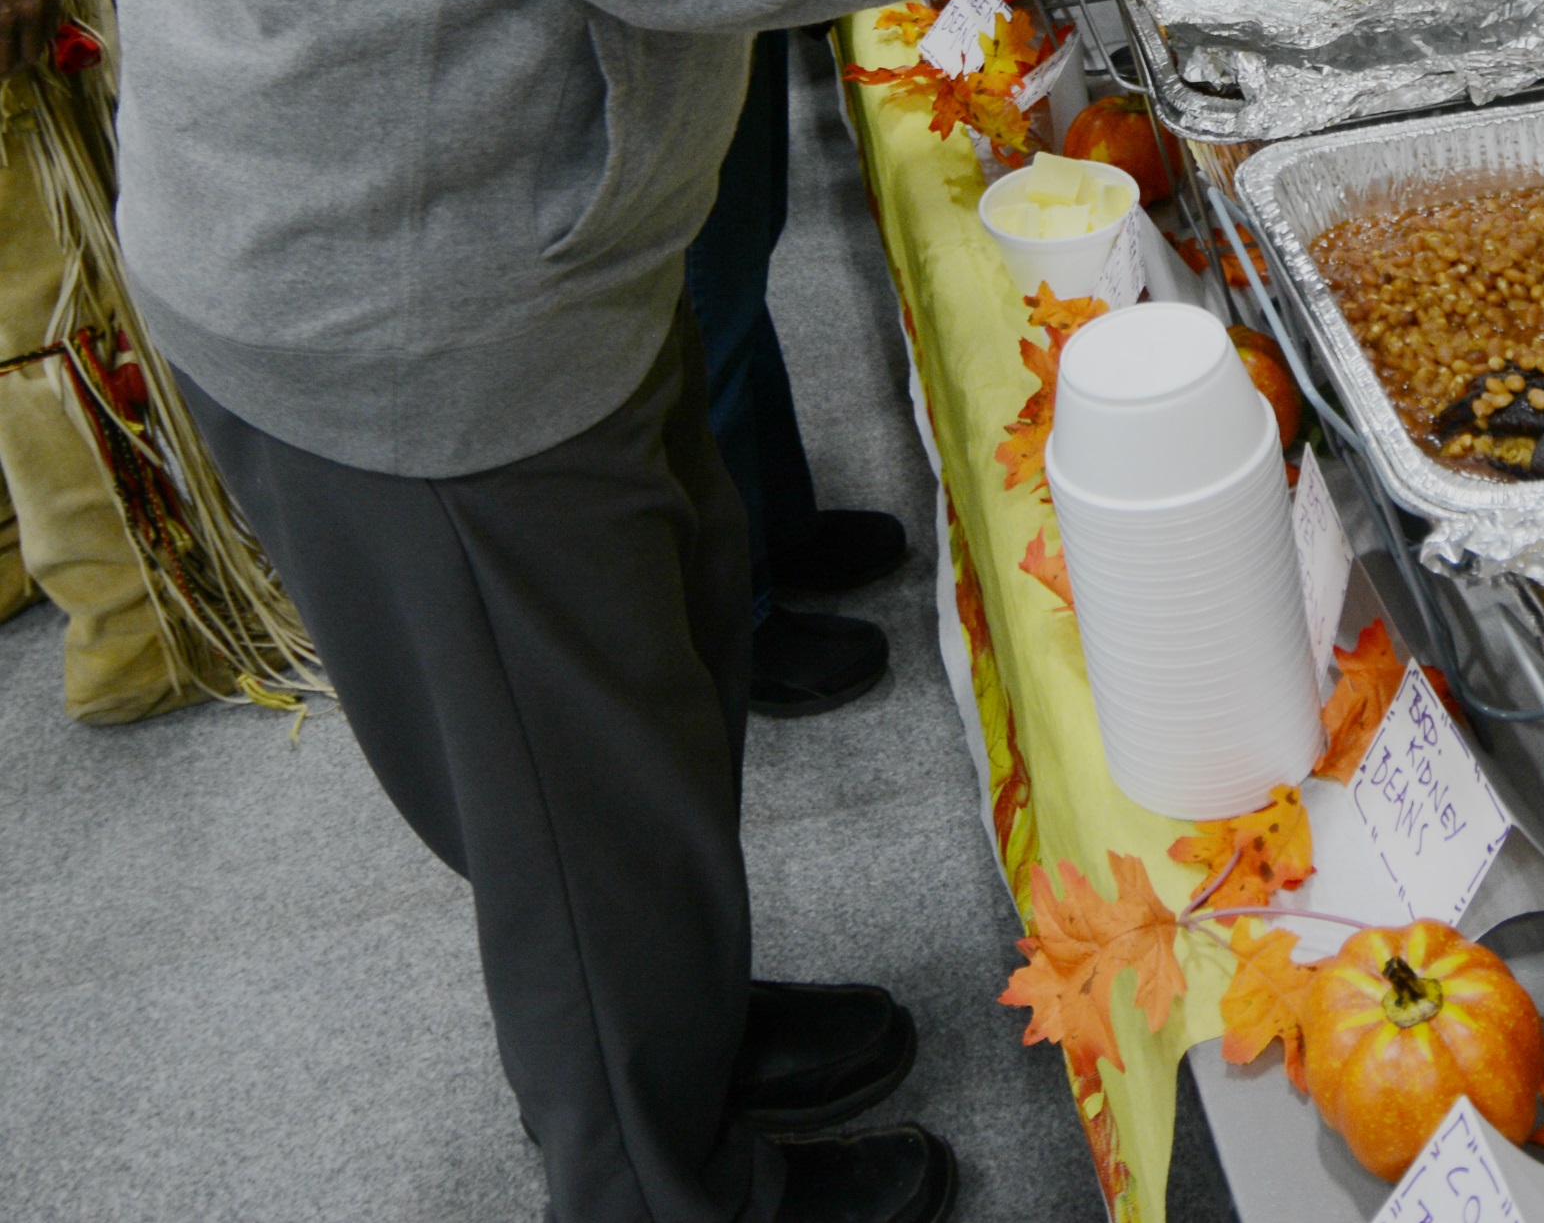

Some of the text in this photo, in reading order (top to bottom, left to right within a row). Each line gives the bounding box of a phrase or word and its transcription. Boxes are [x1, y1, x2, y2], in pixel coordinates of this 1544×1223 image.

[941, 5, 977, 56] BEANS
[1370, 745, 1429, 856] BEANS
[1406, 736, 1467, 842] KIDNEY
